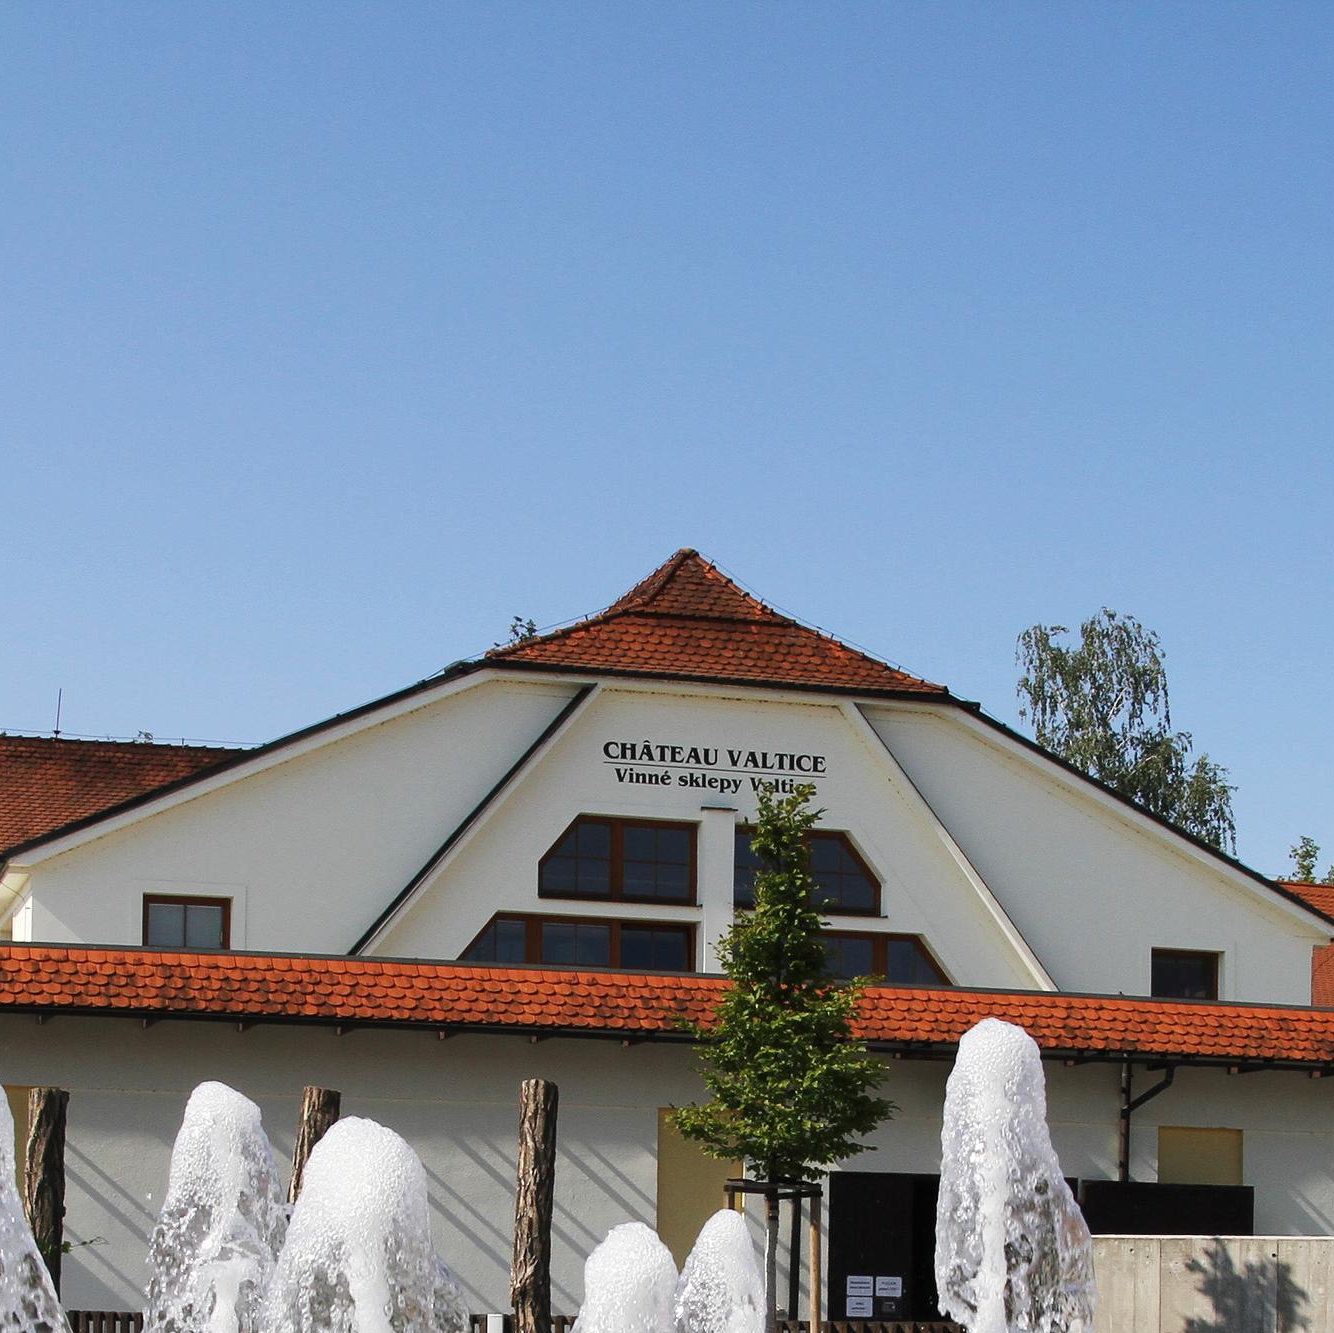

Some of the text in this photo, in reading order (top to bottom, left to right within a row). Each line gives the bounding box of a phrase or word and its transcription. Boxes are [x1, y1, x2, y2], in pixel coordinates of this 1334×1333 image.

[603, 740, 827, 773] CHÂTEAU VALTICE
[615, 768, 817, 795] Vinné sklepy Valti
